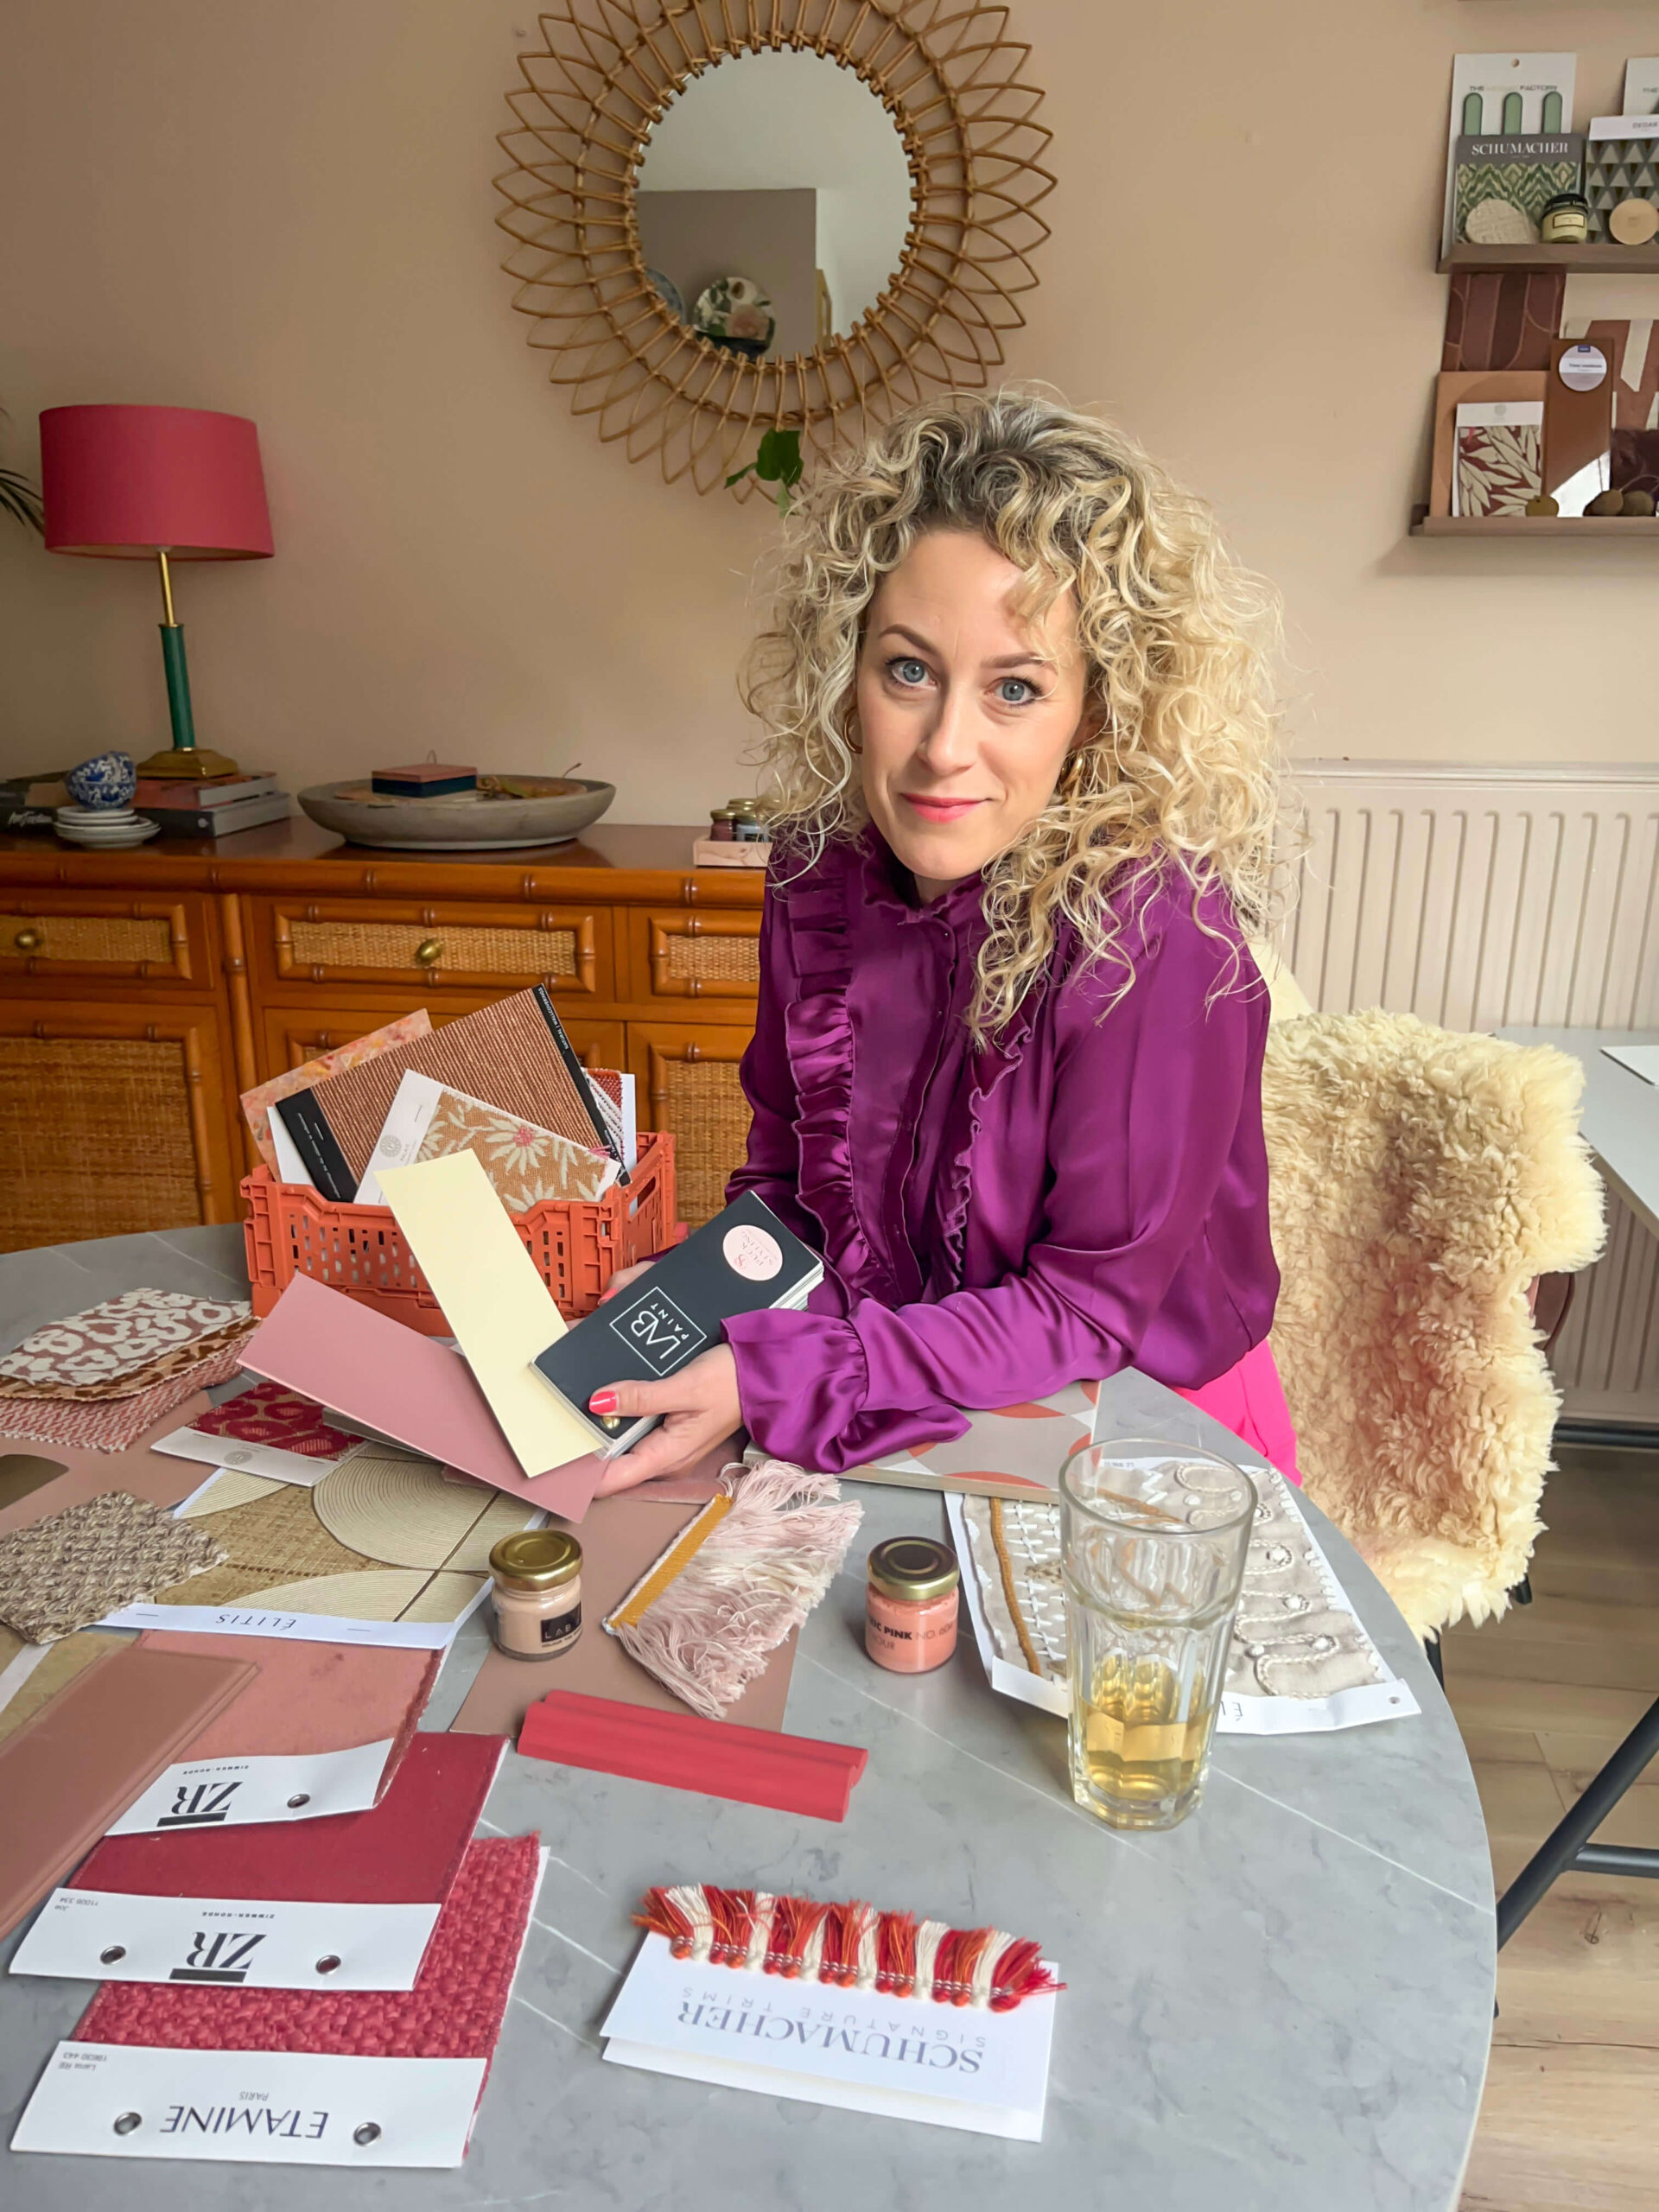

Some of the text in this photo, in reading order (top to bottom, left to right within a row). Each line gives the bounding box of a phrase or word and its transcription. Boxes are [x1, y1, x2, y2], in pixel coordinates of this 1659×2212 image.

[1471, 142, 1569, 156] SCHUMACHER
[556, 1027, 570, 1050] NATURAL
[631, 1310, 681, 1360] LAB
[650, 1302, 690, 1341] PAINT
[215, 1613, 297, 1631] ÉLITIS
[544, 1624, 572, 1640] LAB
[884, 1625, 912, 1641] PINK
[171, 1781, 244, 1815] ZR
[186, 1931, 268, 1969] ZR
[683, 1986, 987, 2049] SIGNATURE TRIMS
[677, 2000, 983, 2074] SCHUMACHER
[238, 2091, 270, 2101] PARIS
[159, 2105, 330, 2139] ETAMINE
